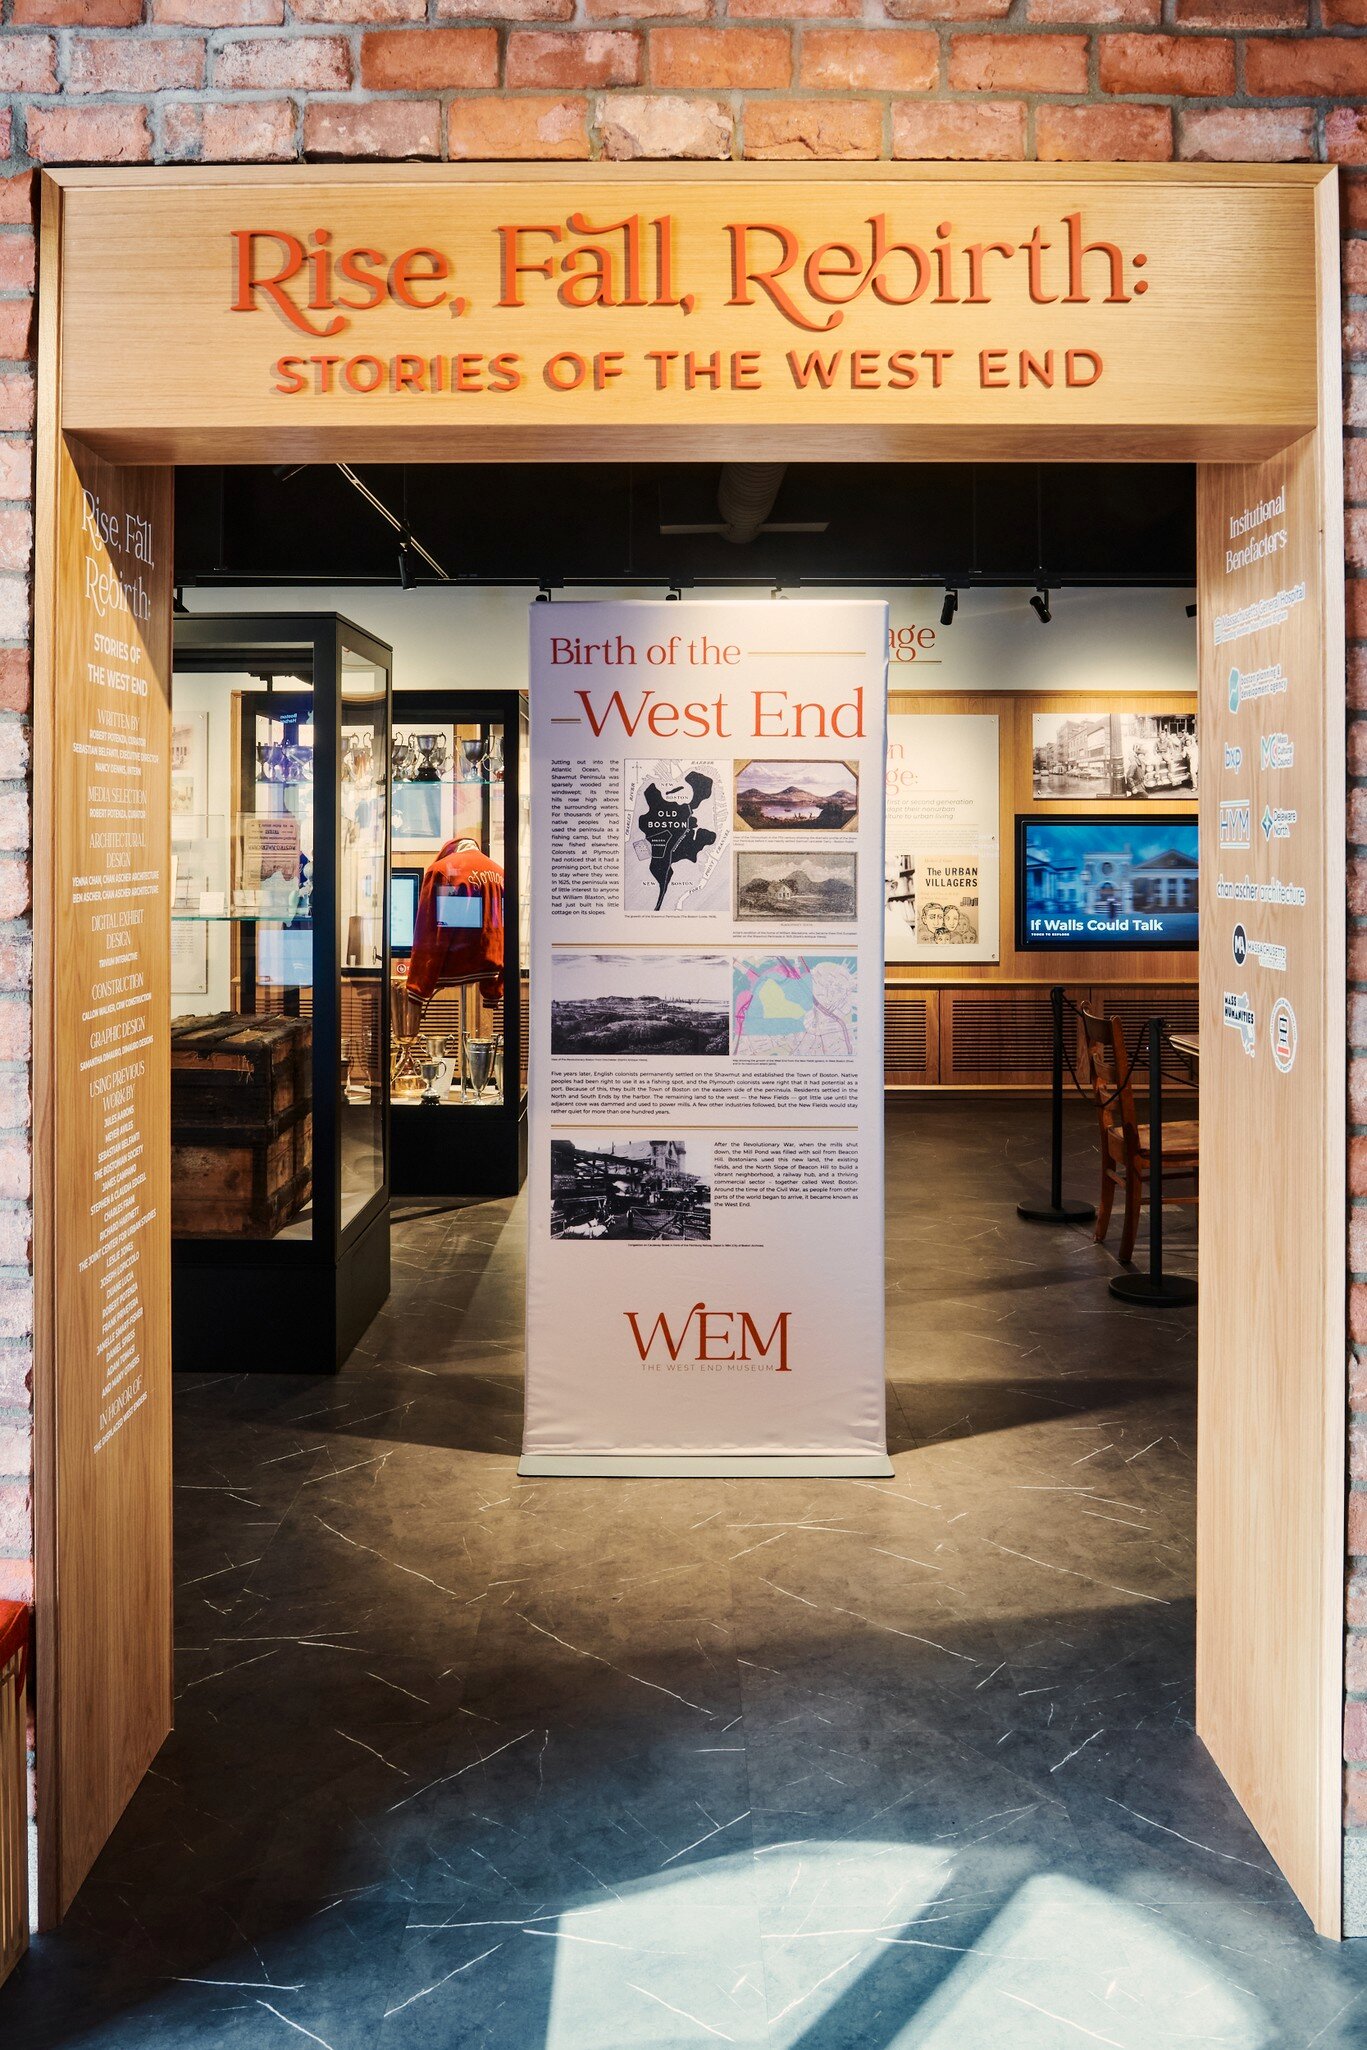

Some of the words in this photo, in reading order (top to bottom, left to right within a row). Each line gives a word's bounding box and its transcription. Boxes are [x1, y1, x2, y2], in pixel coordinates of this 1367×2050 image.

[230, 228, 465, 336] Rise,
[497, 212, 694, 315] Fall,
[723, 211, 1148, 332] Rebirth:
[275, 353, 521, 394] STORIES
[546, 351, 625, 391] OF
[648, 350, 763, 389] THE
[787, 349, 954, 389] WEST
[979, 348, 1104, 389] END
[82, 488, 122, 552] Rise,
[126, 513, 154, 570] Fall,
[85, 556, 151, 621] Rebirth:
[94, 632, 129, 664] STORIES
[129, 643, 141, 664] OF
[551, 636, 636, 665] Birth
[647, 636, 684, 665] of
[688, 636, 741, 665] the
[88, 664, 105, 685] THE
[106, 667, 131, 692] WEST
[132, 673, 148, 697] END
[97, 709, 130, 730] WRITTEN
[131, 716, 140, 730] BY
[574, 689, 732, 738] West
[751, 686, 866, 738] End
[1225, 745, 1241, 772] bxp
[88, 786, 110, 802] MEDIA
[112, 788, 147, 804] SELECTION
[936, 799, 973, 807] generation
[648, 821, 687, 829] BOSTON
[658, 810, 678, 818] OLD
[1220, 808, 1250, 841] HYM
[1273, 810, 1296, 823] Delaware
[89, 833, 146, 848] ARCHITECTURAL
[107, 852, 130, 868] DESIGN
[928, 868, 941, 876] The
[945, 868, 978, 876] URBAN
[926, 879, 978, 887] VILLAGERS
[1217, 877, 1232, 897] chan
[1235, 879, 1257, 899] ascher
[1260, 881, 1305, 904] architecture
[92, 913, 118, 932] DIGITAL
[120, 909, 144, 927] EXHIBIT
[1031, 919, 1041, 931] If
[1044, 919, 1083, 931] Walls
[1087, 919, 1129, 931] Could
[1133, 919, 1163, 931] Talk
[107, 930, 130, 949] DESIGN
[92, 972, 143, 1000] CONSTRUCTION
[1225, 996, 1237, 1006] MASS
[1225, 1006, 1254, 1025] HUMANITIES
[90, 1024, 121, 1050] GRAPHIC
[122, 1016, 146, 1038] DESIGN
[89, 1075, 112, 1098] USING
[112, 1060, 145, 1086] PREVIOUS
[102, 1088, 126, 1112] WORK
[127, 1084, 136, 1100] BY
[623, 1302, 792, 1371] WEM
[642, 1363, 661, 1372] THE
[667, 1363, 695, 1372] WEST
[700, 1363, 723, 1372] END
[727, 1363, 774, 1372] MUSEUM
[99, 1408, 107, 1431] IN
[108, 1386, 132, 1422] HONOR
[133, 1374, 142, 1395] OF
